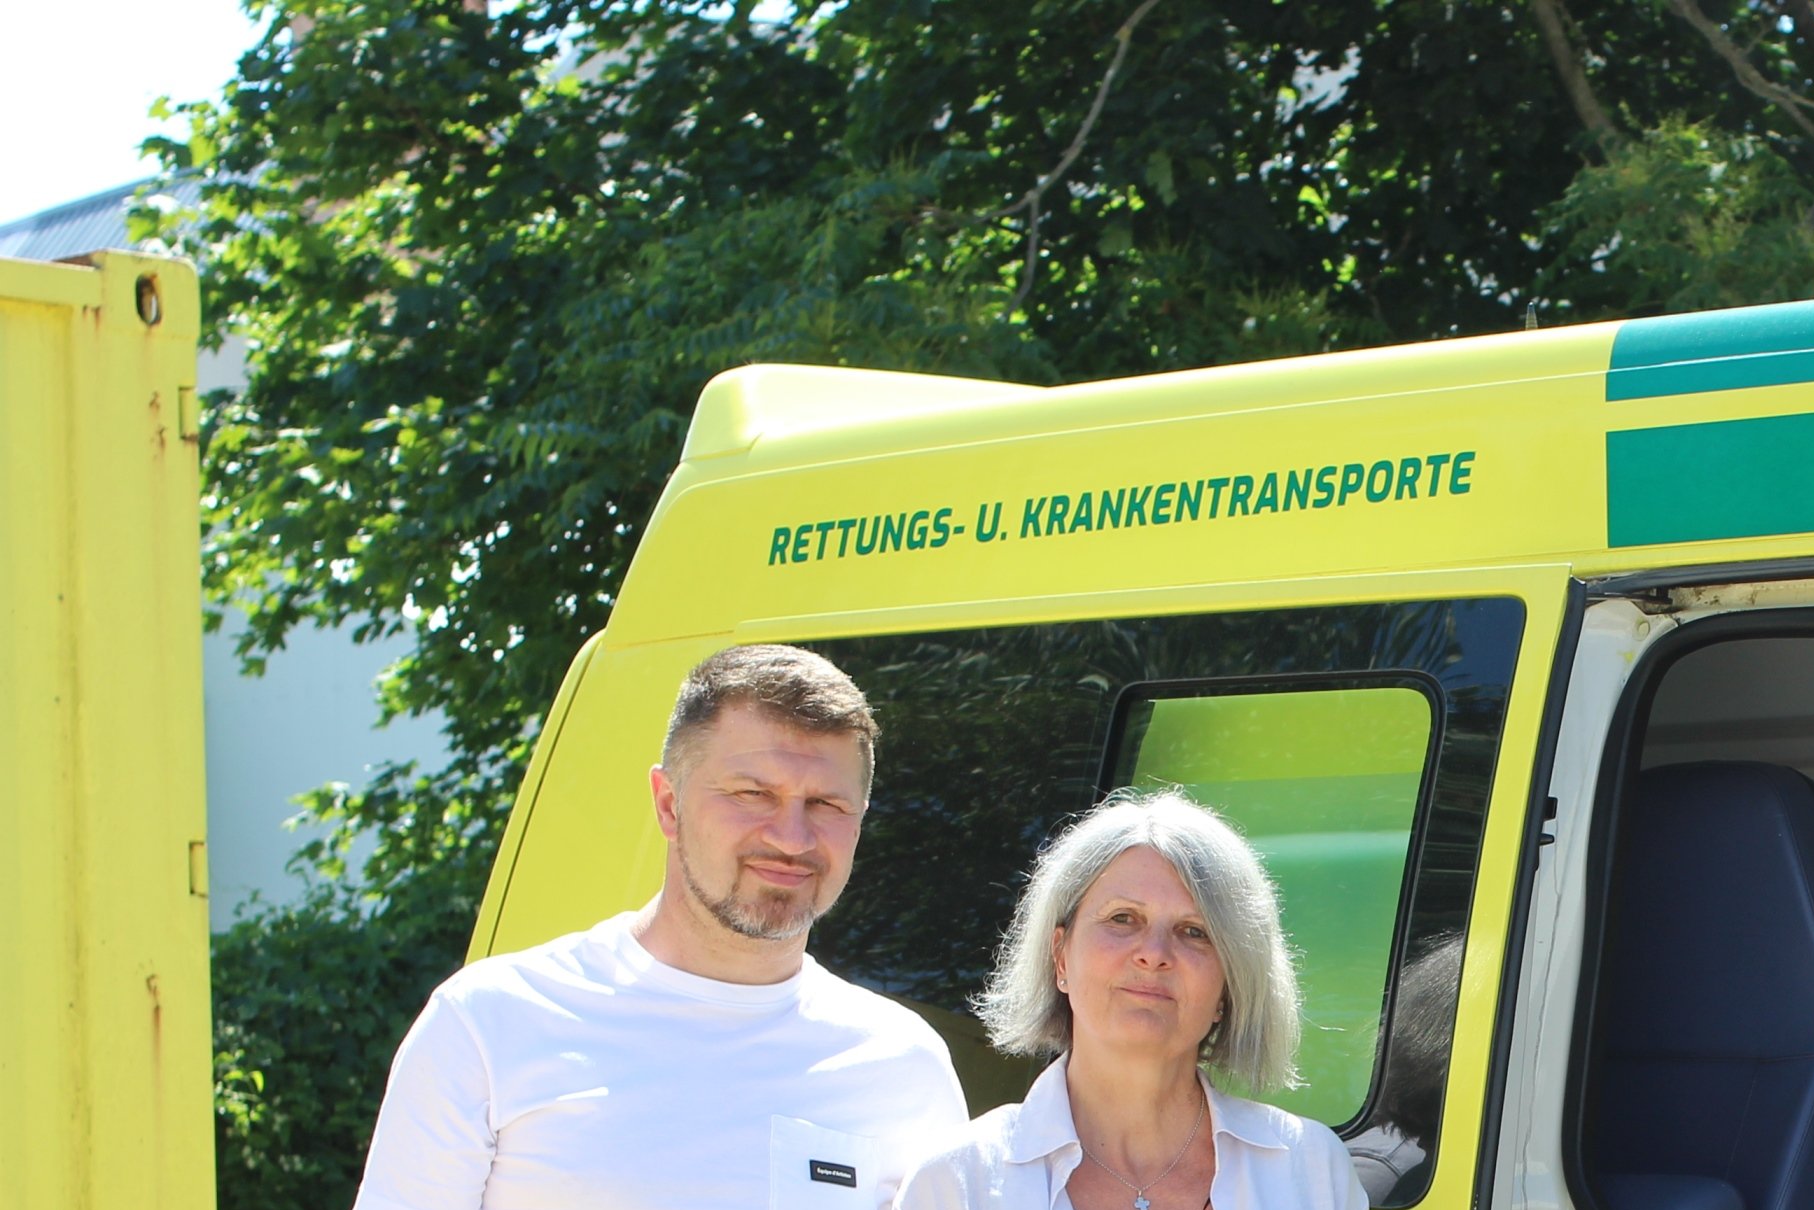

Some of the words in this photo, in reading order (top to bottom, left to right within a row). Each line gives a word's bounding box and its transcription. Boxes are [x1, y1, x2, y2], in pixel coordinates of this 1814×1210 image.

[768, 507, 966, 566] RETTUNGS-
[975, 501, 1007, 543] U.
[1019, 451, 1477, 539] KRANKENTRANSPORTE
